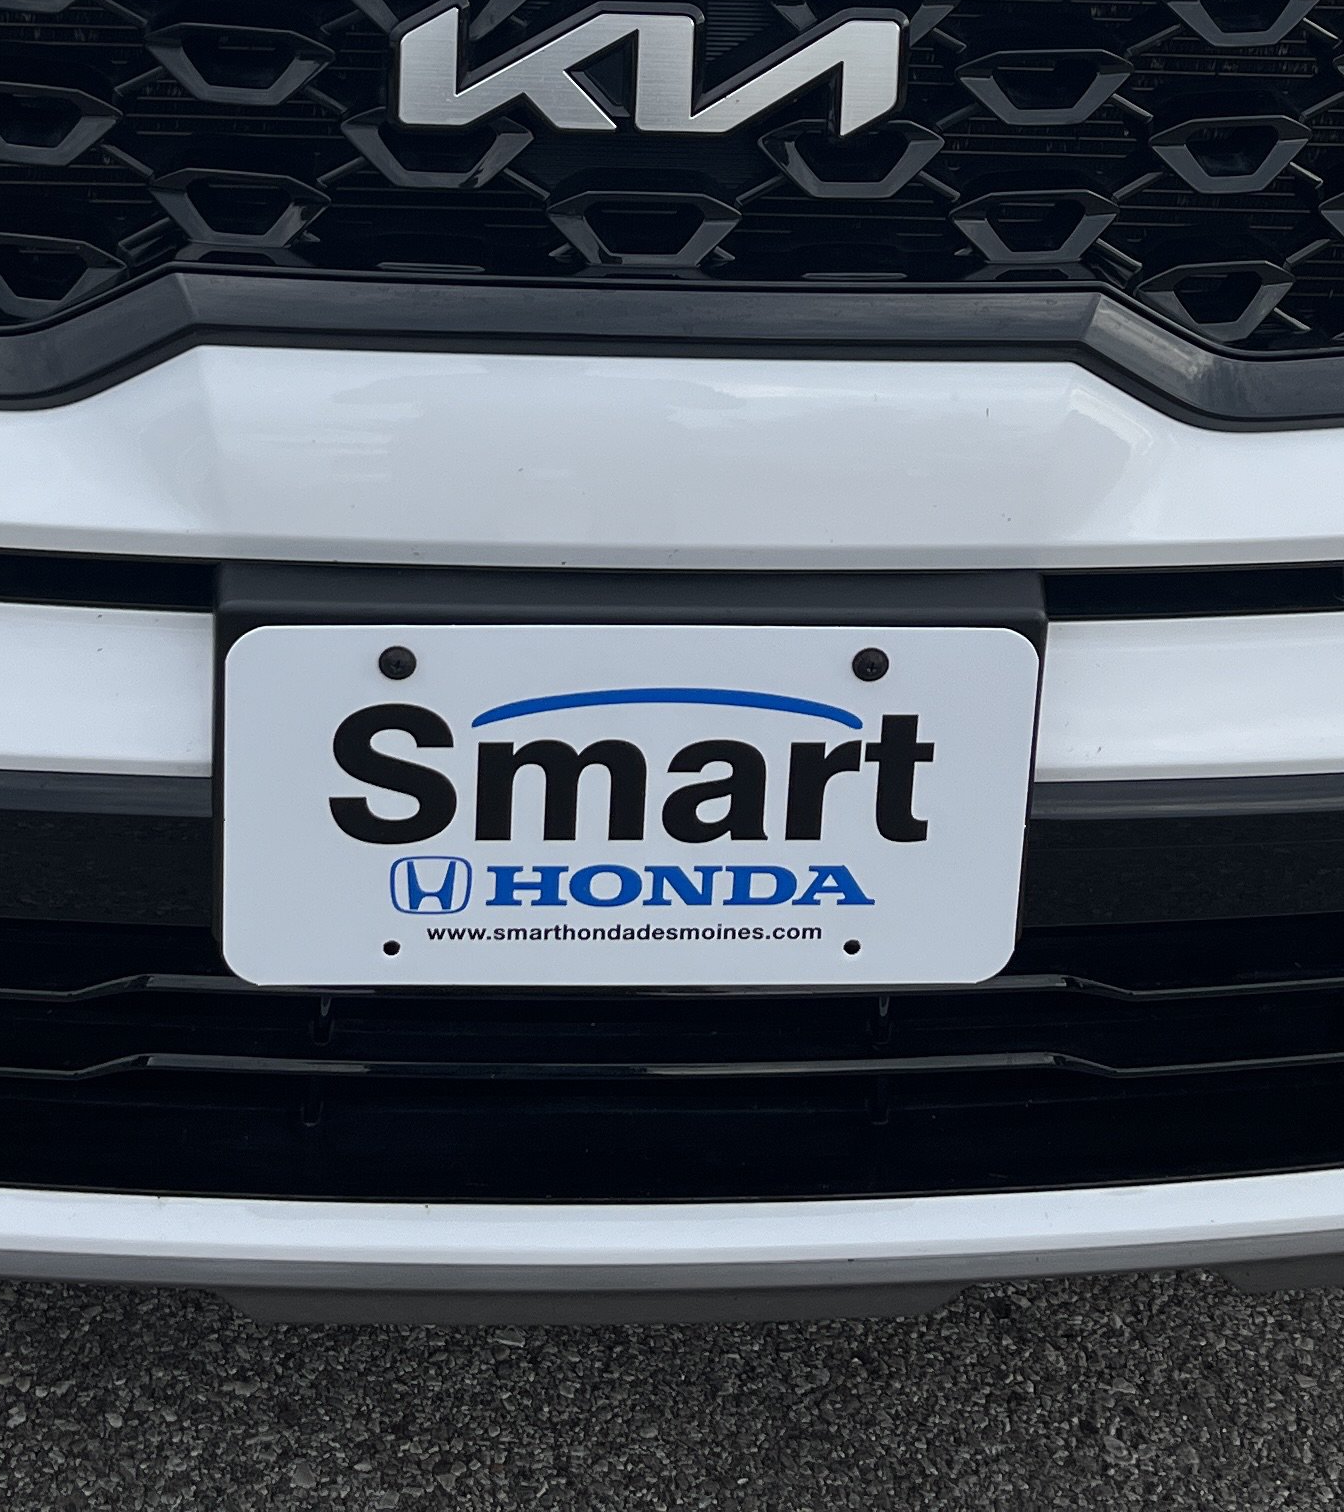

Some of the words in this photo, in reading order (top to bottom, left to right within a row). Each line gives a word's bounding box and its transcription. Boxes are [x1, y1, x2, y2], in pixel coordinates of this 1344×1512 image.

[398, 5, 901, 137] KIA
[328, 703, 936, 845] Smart
[485, 863, 876, 908] HONDA
[426, 923, 823, 942] www.smarthondadesmoines.com
